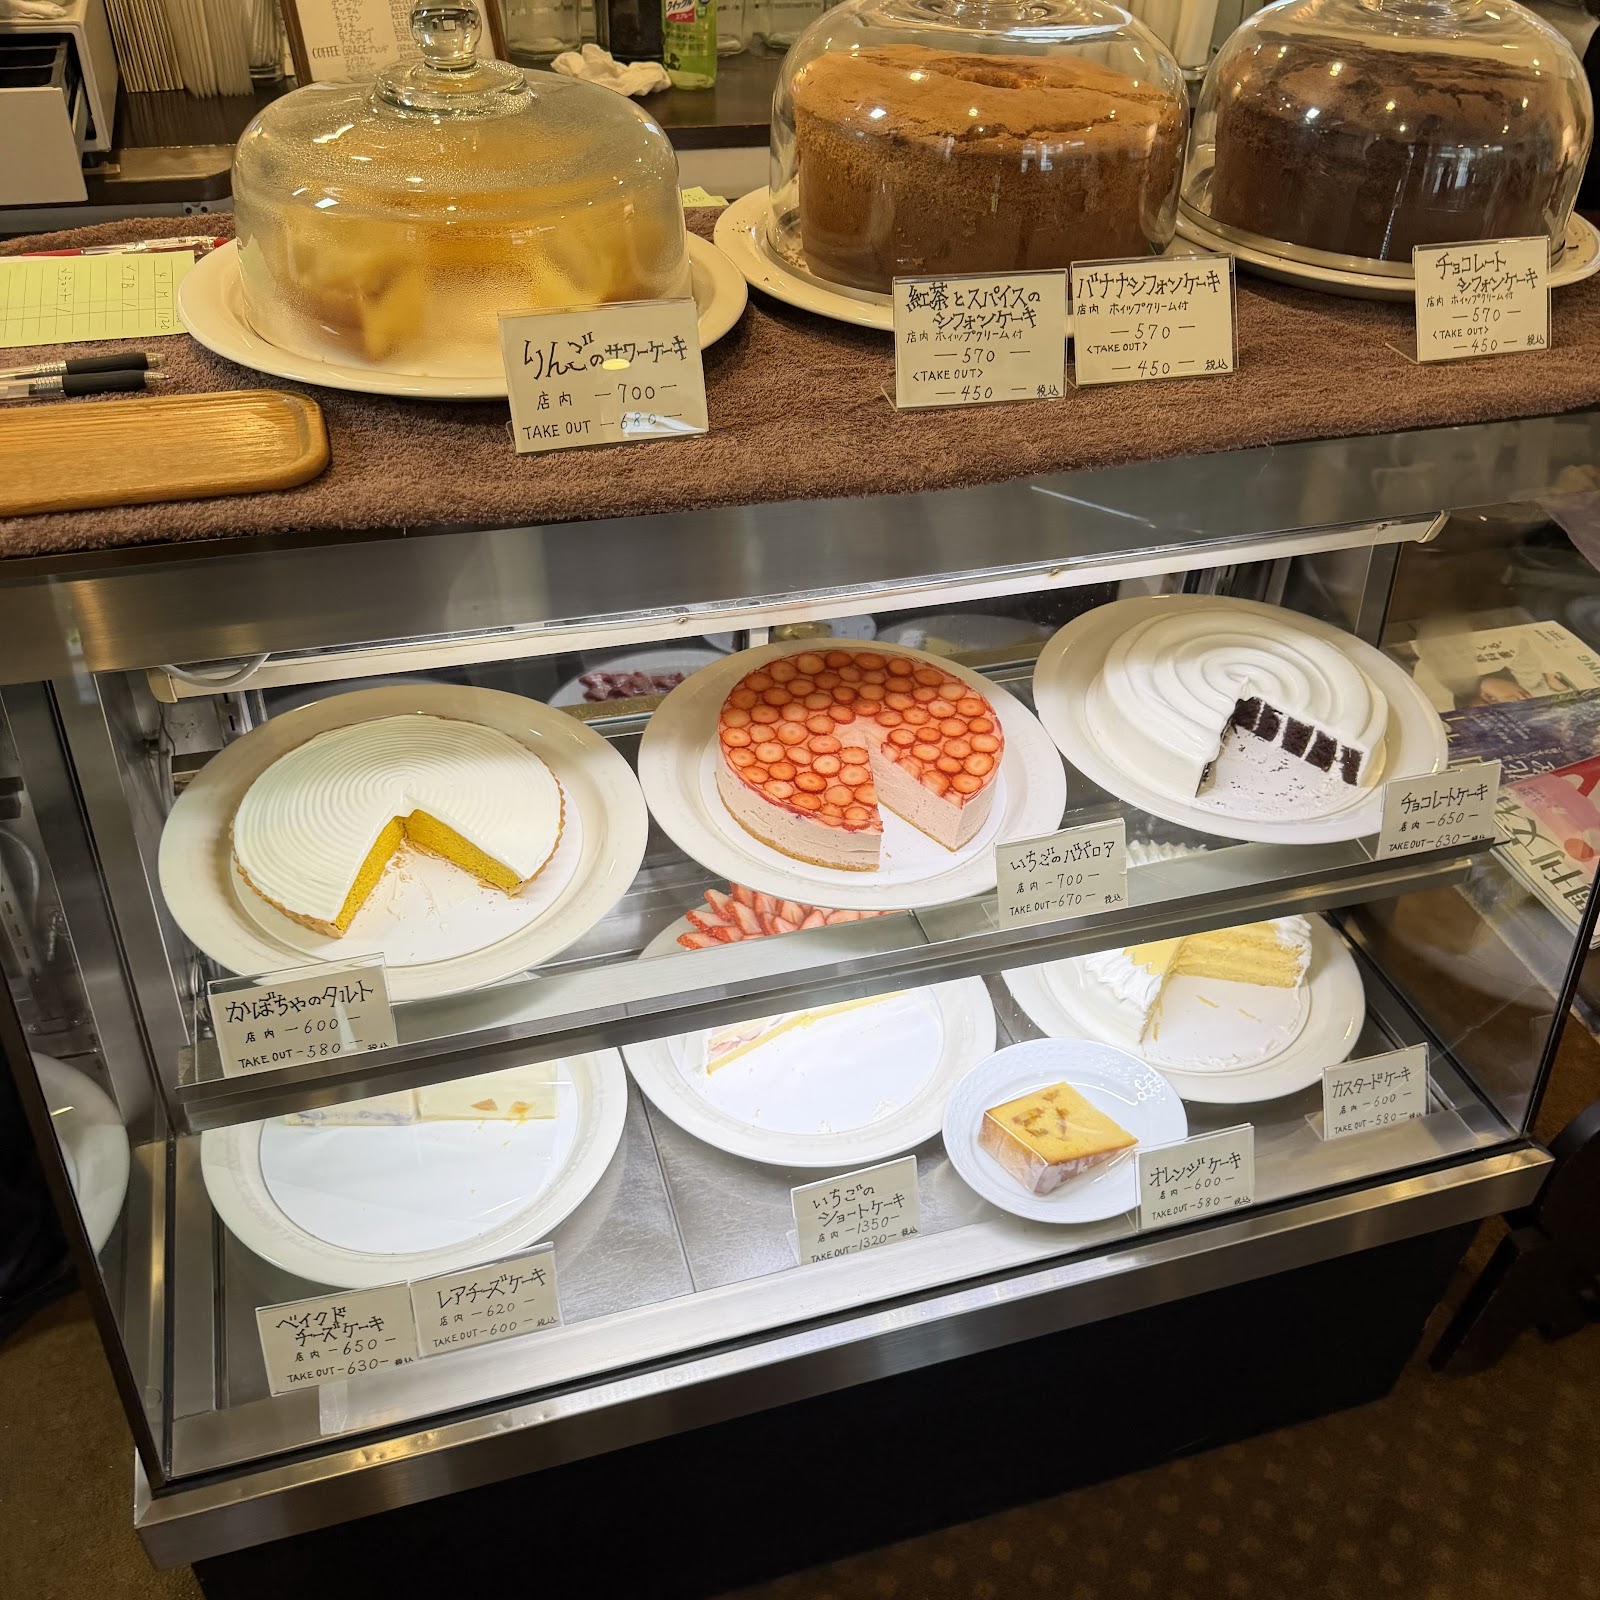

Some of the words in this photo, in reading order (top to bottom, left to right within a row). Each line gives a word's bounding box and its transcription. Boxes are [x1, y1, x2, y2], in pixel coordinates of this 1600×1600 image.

[312, 45, 341, 59] COFFEE
[1436, 250, 1507, 280] チョコレート
[1076, 270, 1221, 299] バナナシフォンケーキ
[1456, 267, 1539, 294] シフォンケーキ
[905, 282, 1041, 312] 紅茶とスパイスの
[1426, 295, 1444, 308] 店内
[932, 305, 1037, 330] シフォンケーキ
[1076, 303, 1100, 316] 店内
[1109, 301, 1189, 316] ホイップクリーム付
[906, 331, 929, 343] 店内
[935, 329, 1023, 342] ホイップクリーム付
[523, 331, 688, 380] りんごのサワーケーキ
[1204, 358, 1229, 371] 税込
[536, 391, 573, 411] 店内
[1036, 384, 1060, 398] 税込
[523, 424, 560, 440] TAKE
[565, 420, 591, 435] OUT
[1401, 783, 1488, 814] チョコレートケーキ
[1399, 821, 1420, 832] 店内
[1389, 841, 1409, 851] TAKE
[1410, 839, 1426, 848] OUT
[1010, 840, 1115, 873] いちごのババロア
[1016, 881, 1039, 894] 店内
[1009, 904, 1032, 916] TAKE
[1034, 900, 1050, 911] OUT
[225, 980, 374, 1023] かぼちゃのタルト
[245, 1028, 275, 1044] 店内
[238, 1055, 270, 1069] TAKE
[272, 1049, 293, 1061] OUT
[1332, 1066, 1411, 1098] カスタードケーキ
[1334, 1123, 1352, 1134] TAKE
[1354, 1120, 1367, 1130] OUT
[1149, 1152, 1241, 1187] オレンジケーキ
[812, 1183, 875, 1209] いちごの
[818, 1192, 905, 1227] ショートケーキ
[1152, 1209, 1172, 1220] TAKE
[1174, 1204, 1188, 1215] OUT
[810, 1250, 832, 1263] TAKE
[834, 1246, 850, 1257] OUT
[437, 1268, 547, 1309] レアチーズケーキ
[275, 1306, 347, 1329] ベイクド
[439, 1314, 463, 1327] 店内
[295, 1316, 385, 1347] チーズケーキ
[432, 1334, 458, 1348] TAKE
[460, 1329, 478, 1340] OUT
[294, 1350, 320, 1363] 店内
[287, 1371, 314, 1383] TAKE
[316, 1366, 335, 1377] OUT
